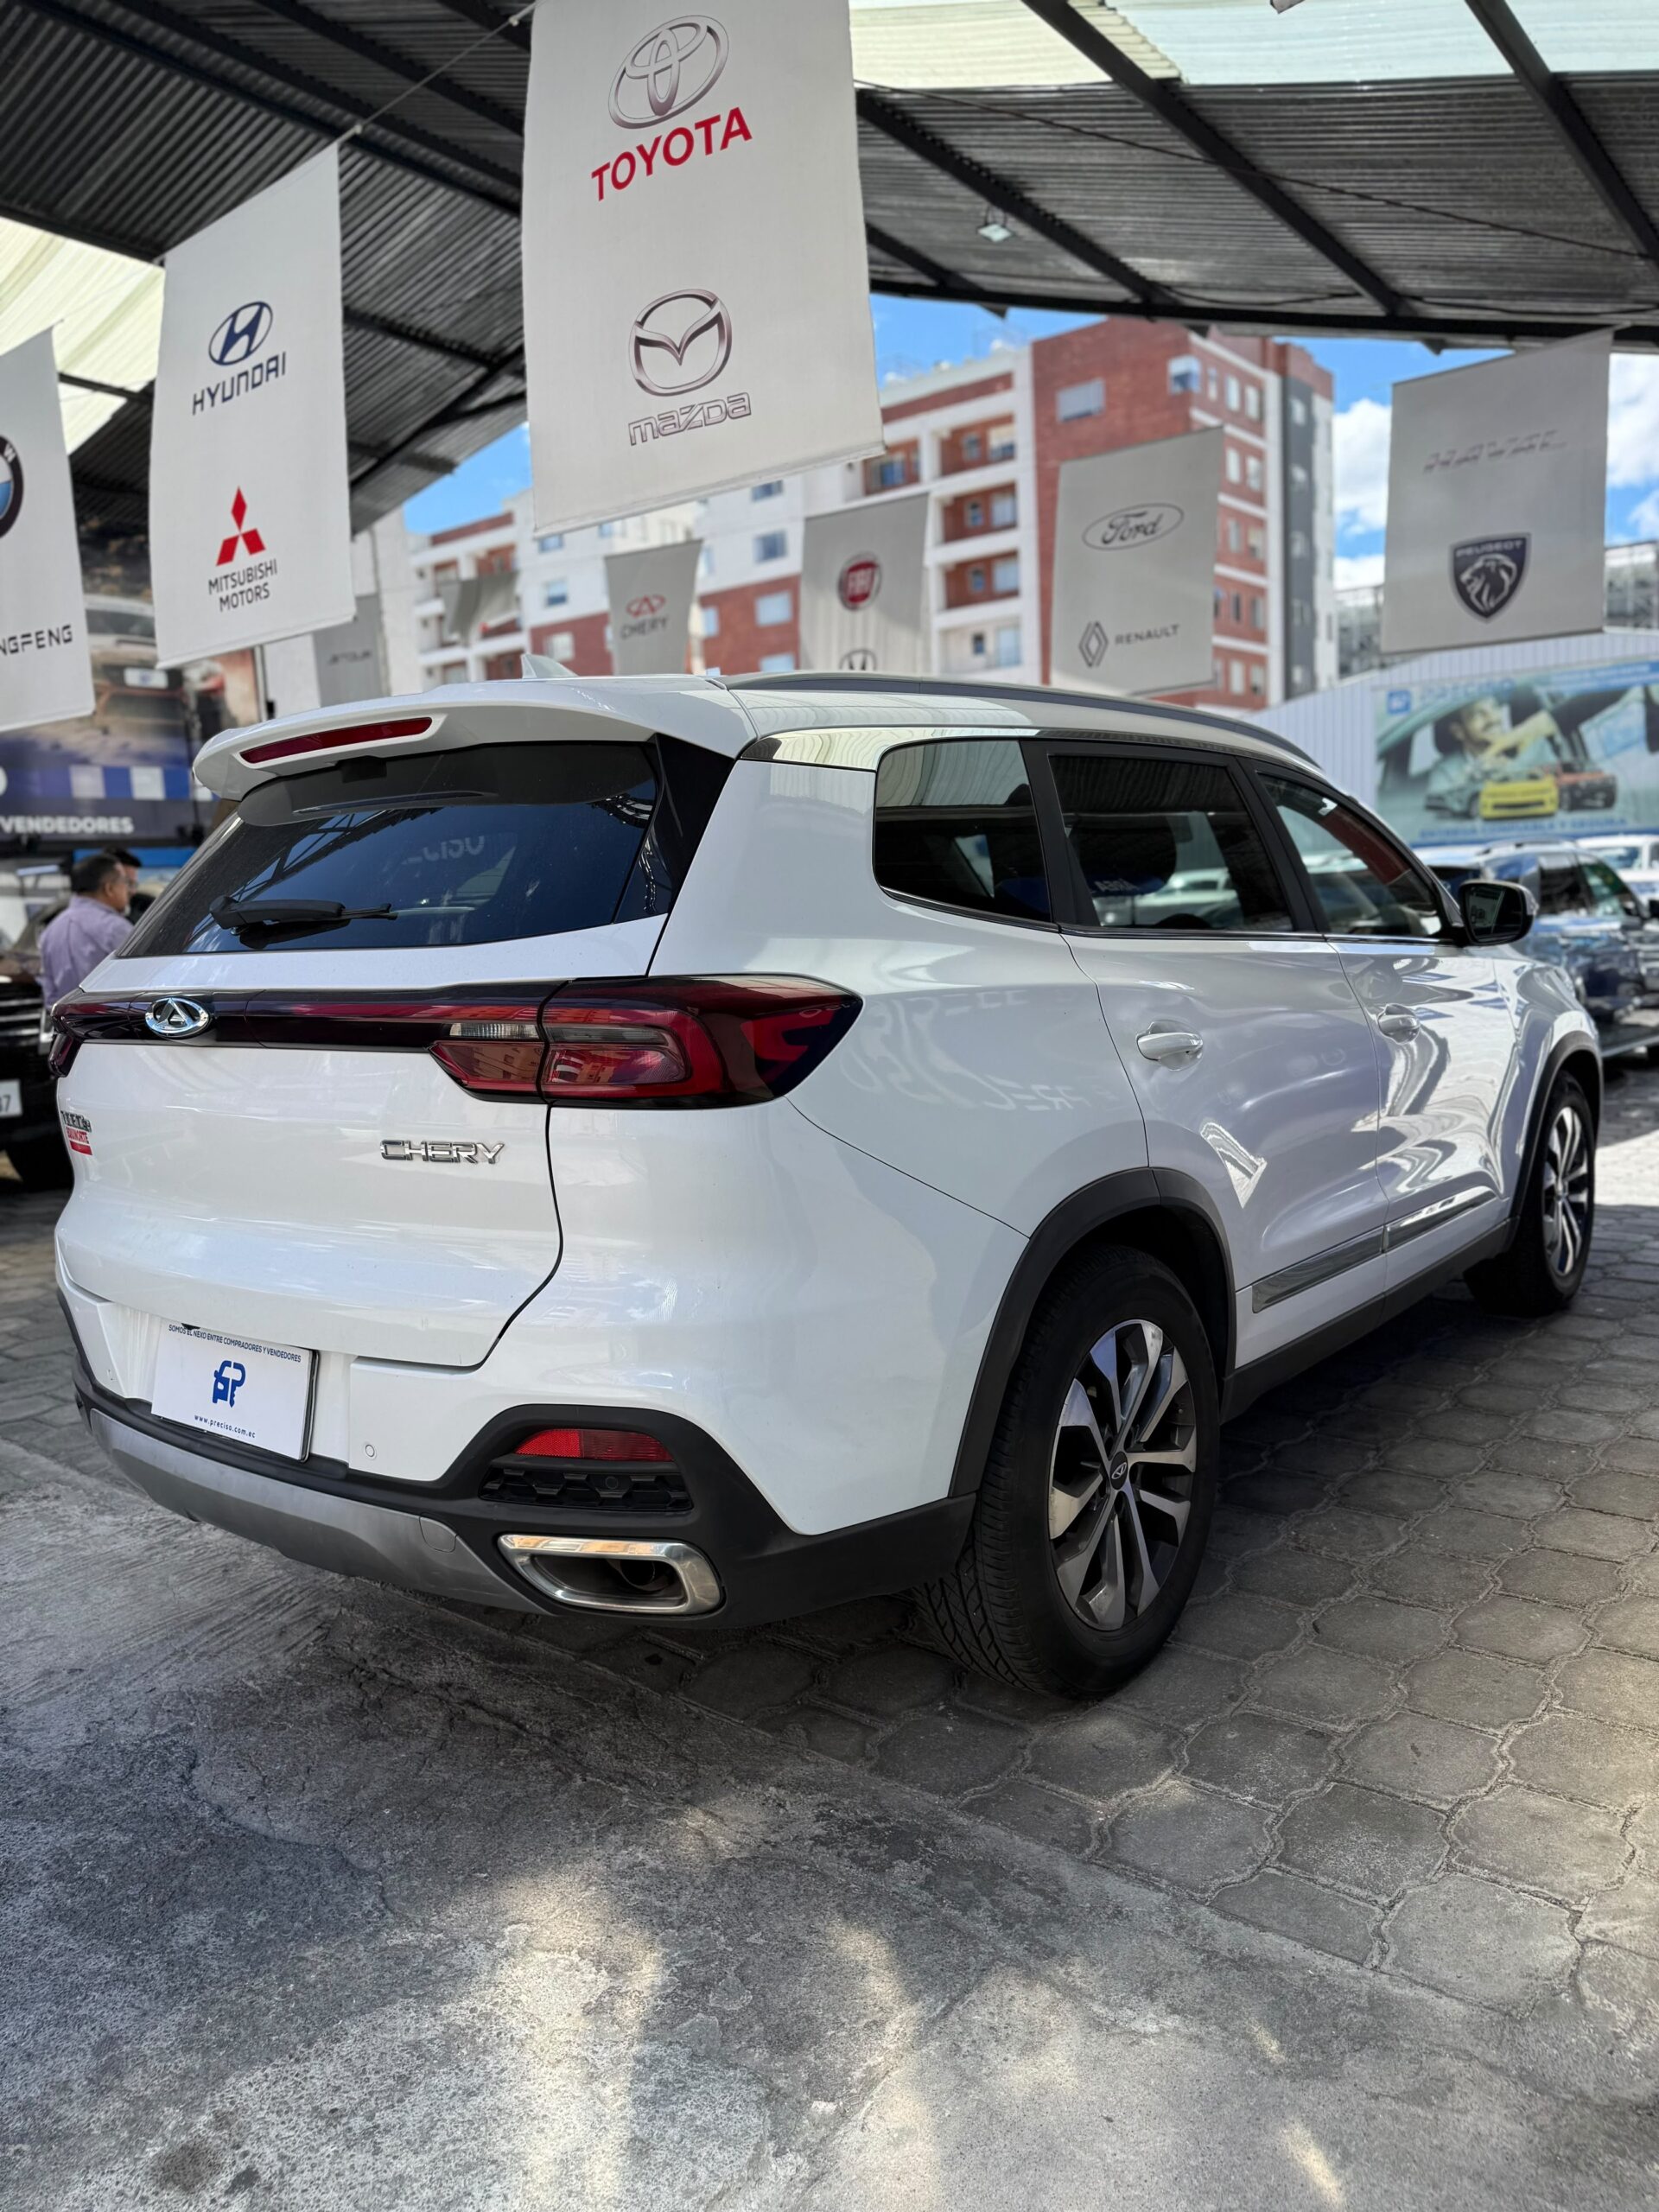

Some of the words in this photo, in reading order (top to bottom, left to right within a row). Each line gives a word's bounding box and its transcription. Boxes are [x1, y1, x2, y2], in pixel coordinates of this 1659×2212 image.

[591, 106, 753, 201] TOYOTA
[192, 352, 286, 416] HYUNDAI
[1101, 511, 1164, 545] Ford
[1456, 539, 1522, 557] PEUGEOT
[208, 558, 278, 595] MITSUBISHI
[219, 582, 270, 613] MOTORS
[1116, 624, 1179, 645] RENAULT
[1, 816, 134, 835] VENDEDORES
[380, 1139, 505, 1165] CHERY
[168, 1324, 187, 1335] SOMOS
[194, 1330, 207, 1339] NEXO
[207, 1332, 223, 1344] ENTRE
[223, 1337, 263, 1353] COMPRADORES
[263, 1345, 267, 1354] Y
[266, 1348, 302, 1363] VENDEDORES
[194, 1414, 257, 1439] www.preciso.com.ec
